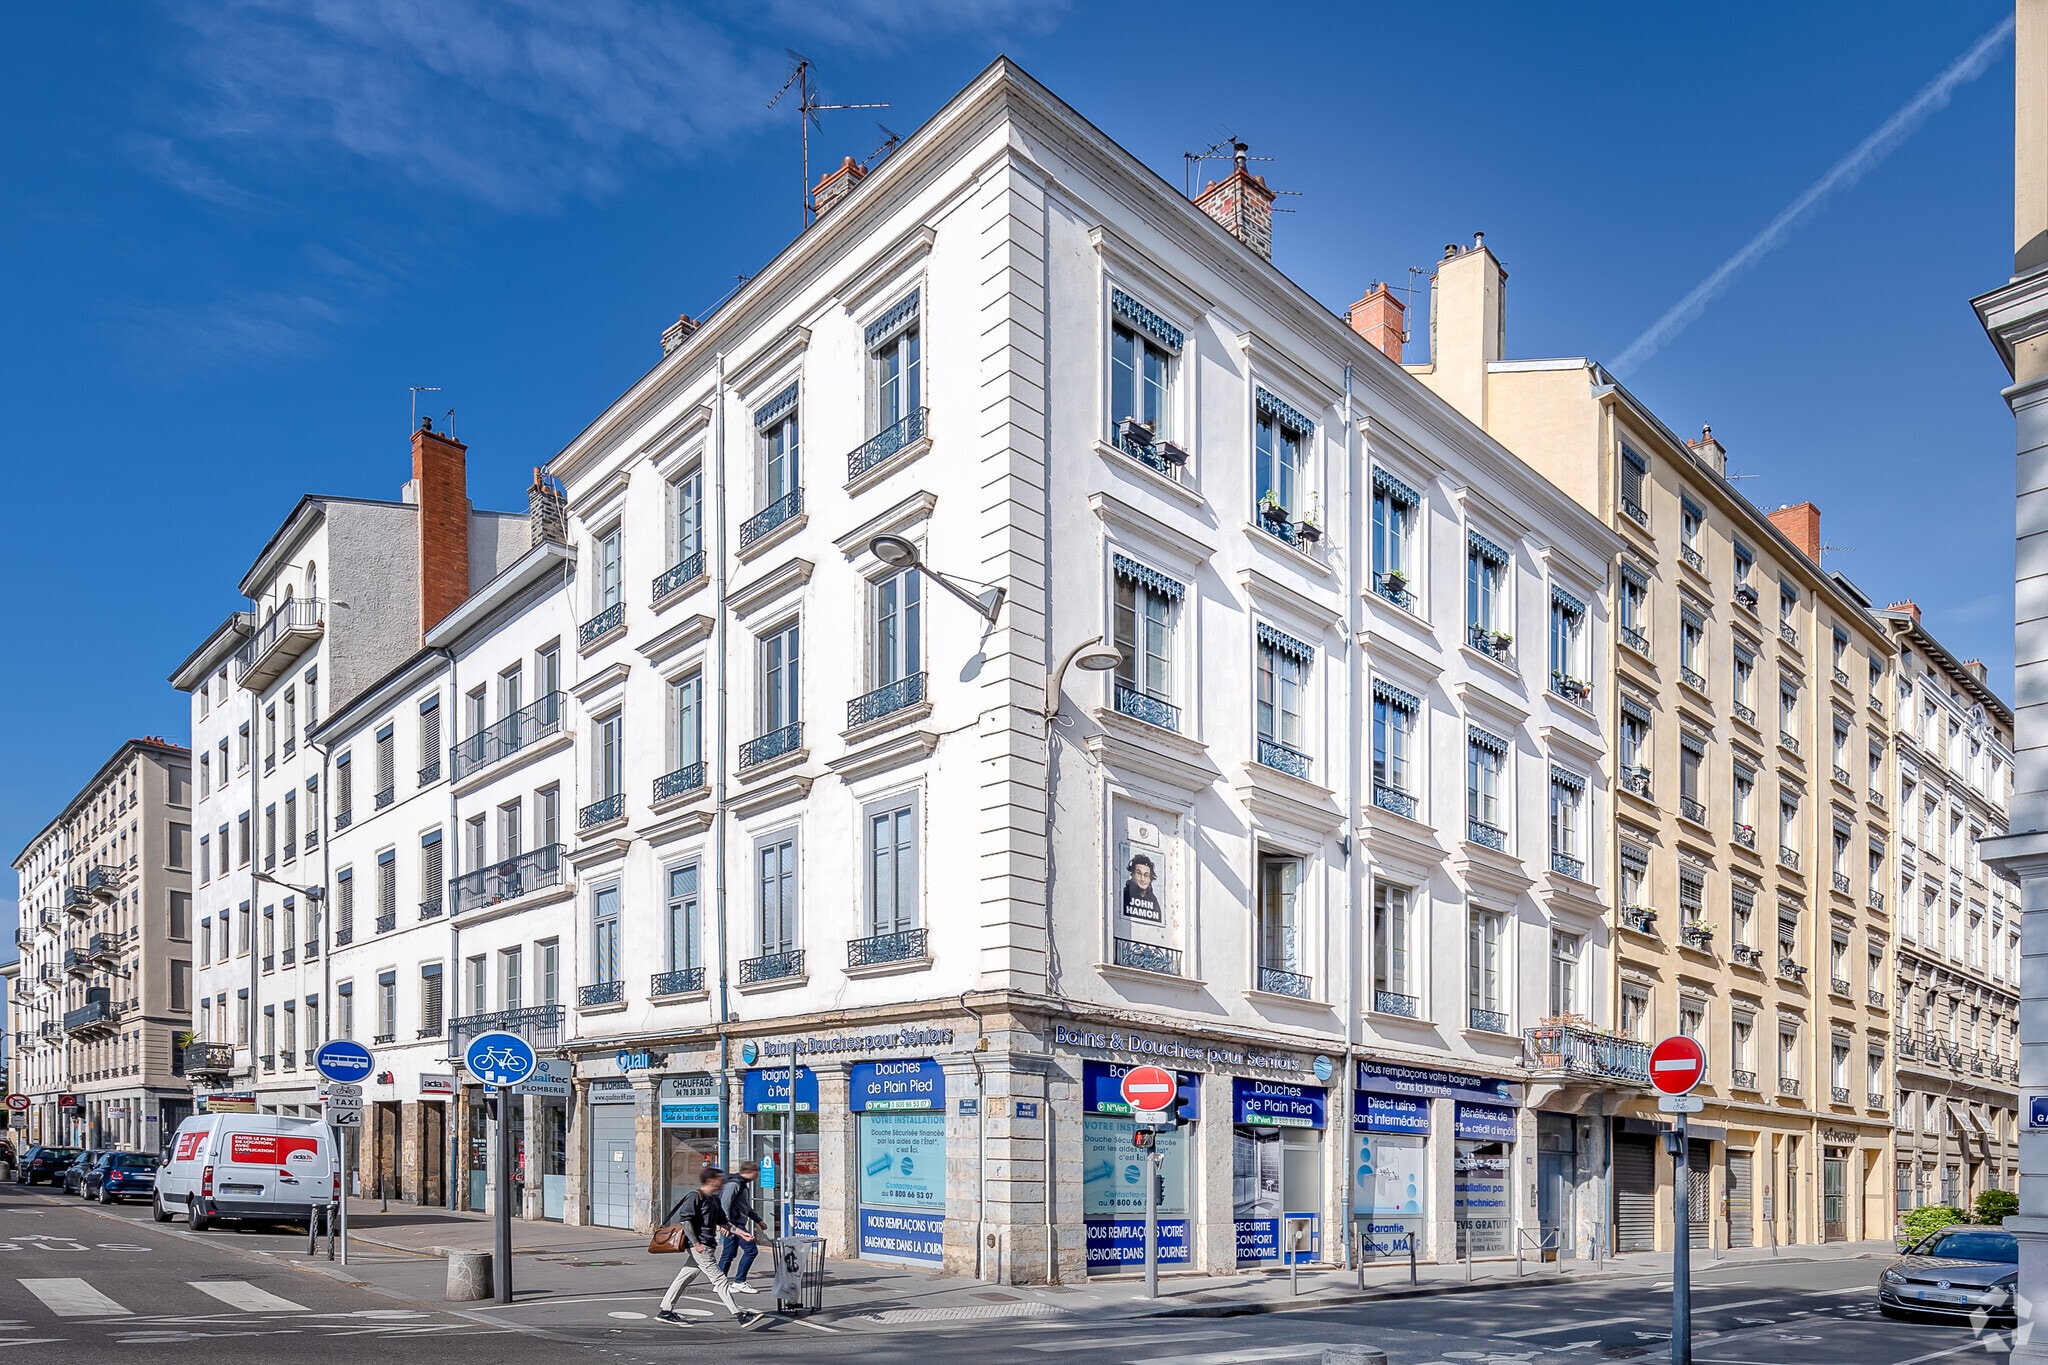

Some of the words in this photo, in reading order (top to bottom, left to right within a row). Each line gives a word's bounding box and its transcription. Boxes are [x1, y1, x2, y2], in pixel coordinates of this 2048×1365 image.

[1130, 897, 1154, 910] JOHN
[1126, 905, 1159, 920] HAMON
[807, 1033, 861, 1053] Douches
[864, 1031, 897, 1053] pour
[1055, 1025, 1106, 1048] Bains
[1111, 1032, 1124, 1050] &
[1128, 1034, 1204, 1060] Douches
[1208, 1048, 1244, 1064] pour
[875, 1062, 921, 1076] Douches
[1361, 1062, 1382, 1074] Nous
[1382, 1066, 1428, 1081] remplaçons
[1429, 1072, 1448, 1082] votre
[1448, 1073, 1481, 1087] baignoire
[423, 1079, 442, 1088] ada
[521, 1085, 566, 1094] PLOMBERIE
[672, 1078, 714, 1089] CHAUFFAGE
[867, 1082, 882, 1095] de
[883, 1080, 907, 1094] Plain
[909, 1078, 934, 1093] Pied
[1255, 1081, 1302, 1097] Douches
[1395, 1080, 1415, 1091] dans
[1415, 1082, 1423, 1092] la
[1423, 1084, 1452, 1096] journée
[767, 1084, 775, 1097] à
[334, 1098, 358, 1107] TAXI
[1246, 1098, 1261, 1110] de
[1264, 1099, 1289, 1113] Plain
[1291, 1101, 1313, 1115] Pied
[1368, 1097, 1394, 1110] Direct
[1394, 1101, 1417, 1112] usine
[870, 1115, 892, 1124] VOTRE
[894, 1115, 945, 1124] INSTALLATION
[1460, 1106, 1497, 1121] Bénéficiez
[1497, 1110, 1508, 1121] de
[1084, 1122, 1114, 1130] VOTRE
[1353, 1114, 1373, 1124] sans
[1374, 1113, 1430, 1128] intermédiaire
[892, 1129, 918, 1137] Sécurisée
[1472, 1125, 1490, 1134] crédit
[877, 1138, 887, 1146] par
[1084, 1135, 1112, 1143] Douche
[1093, 1145, 1106, 1154] par
[1118, 1153, 1135, 1161] c'est
[895, 1190, 906, 1198] 800
[868, 1216, 885, 1229] NOUS
[885, 1218, 926, 1234] REMPLAÇONS
[1161, 1225, 1184, 1238] VOTRE
[1235, 1221, 1271, 1232] SECURITE
[1367, 1223, 1404, 1233] Garantie
[1475, 1220, 1508, 1230] GRATUIT
[864, 1236, 896, 1250] BAIGNOIRE
[896, 1239, 913, 1252] DANS
[913, 1241, 922, 1253] LA
[1122, 1246, 1144, 1260] DANS
